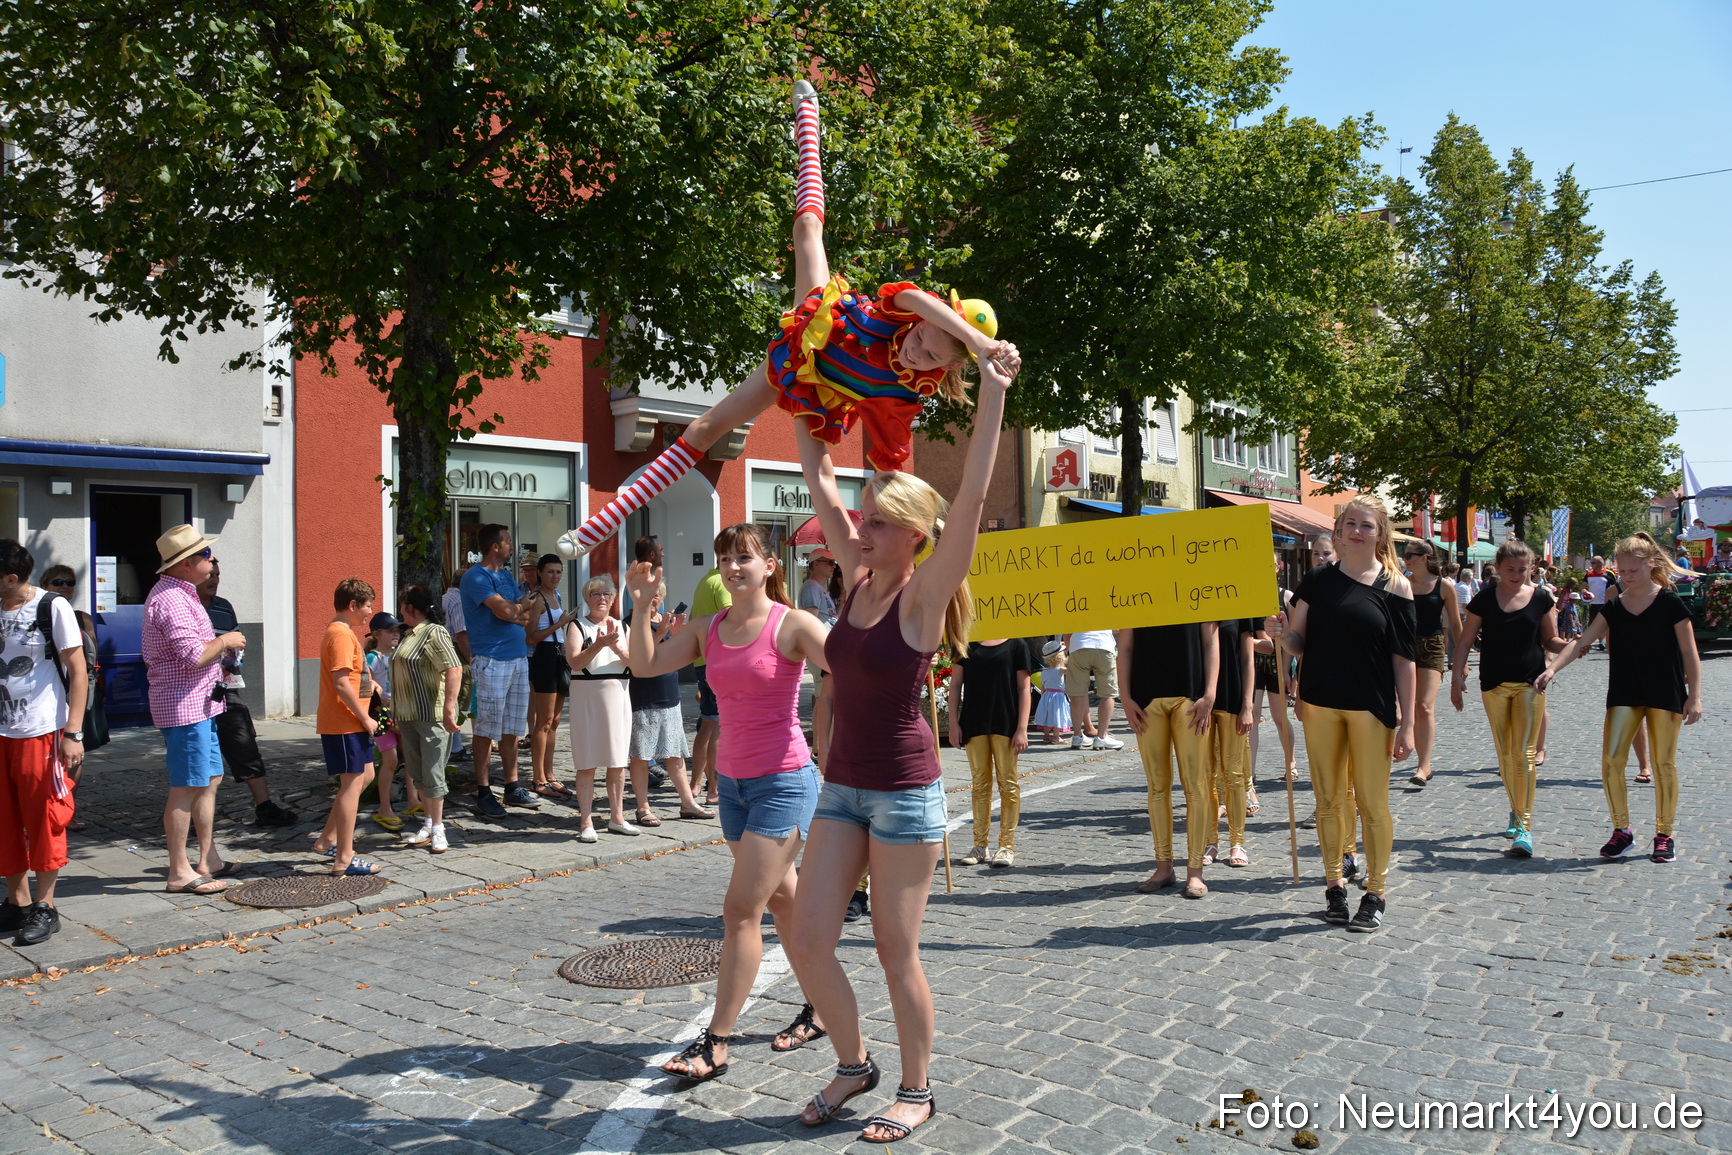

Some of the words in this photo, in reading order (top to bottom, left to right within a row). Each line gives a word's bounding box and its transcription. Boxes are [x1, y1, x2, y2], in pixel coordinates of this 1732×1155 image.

[447, 461, 537, 493] elmann
[774, 484, 812, 509] fielm
[969, 545, 1063, 576] UMARKT
[1070, 545, 1095, 566] da
[1105, 538, 1165, 562] wohn
[1186, 537, 1239, 564] gern
[1065, 590, 1089, 613] da
[1108, 585, 1153, 609] turn
[1189, 584, 1238, 611] gern
